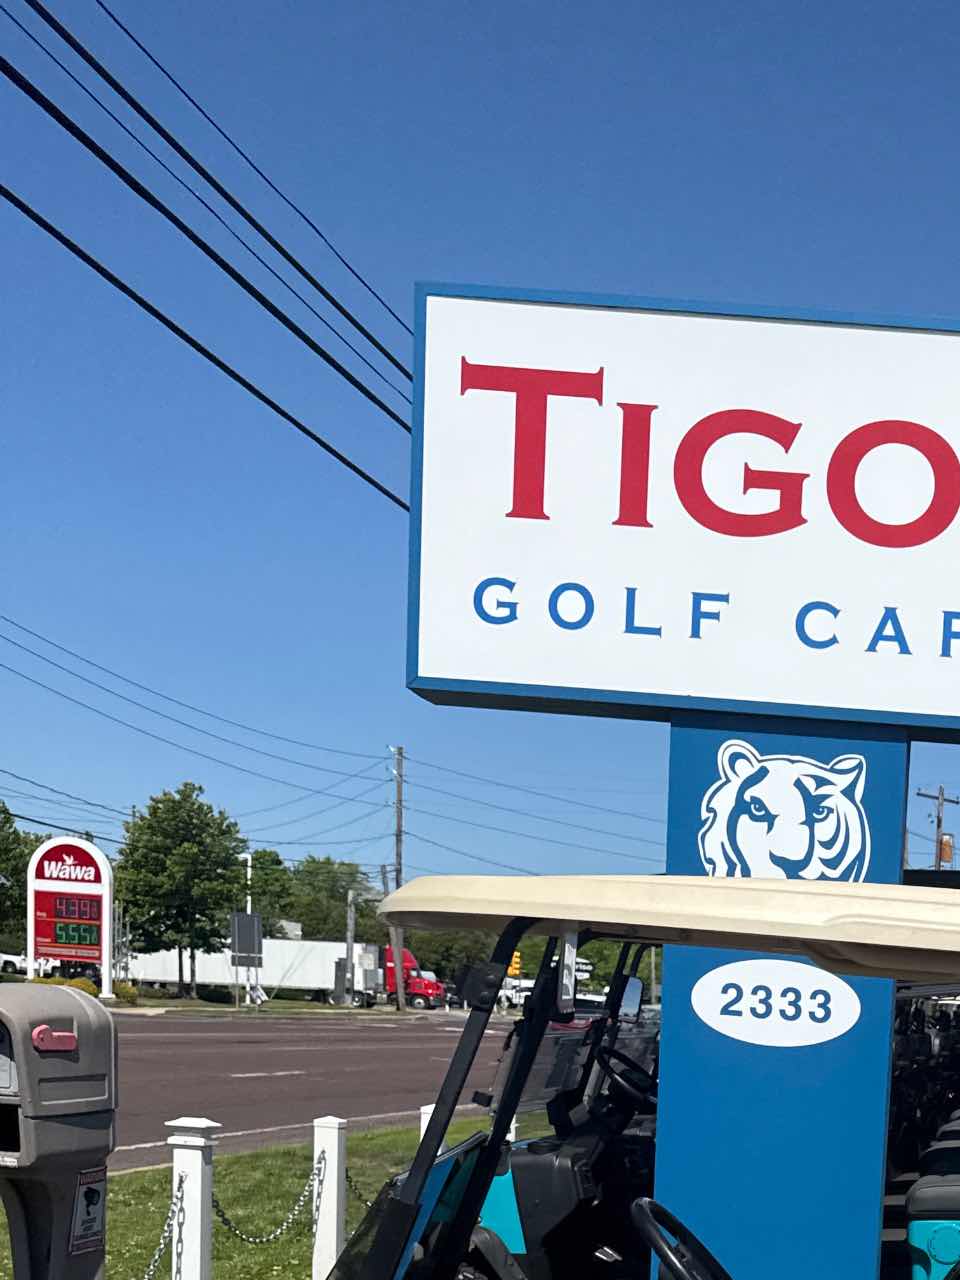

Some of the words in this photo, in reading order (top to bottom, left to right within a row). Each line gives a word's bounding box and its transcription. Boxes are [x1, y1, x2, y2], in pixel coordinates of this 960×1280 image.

[472, 576, 731, 640] GOLF
[43, 860, 96, 881] Wawa
[720, 982, 832, 1024] 2333
